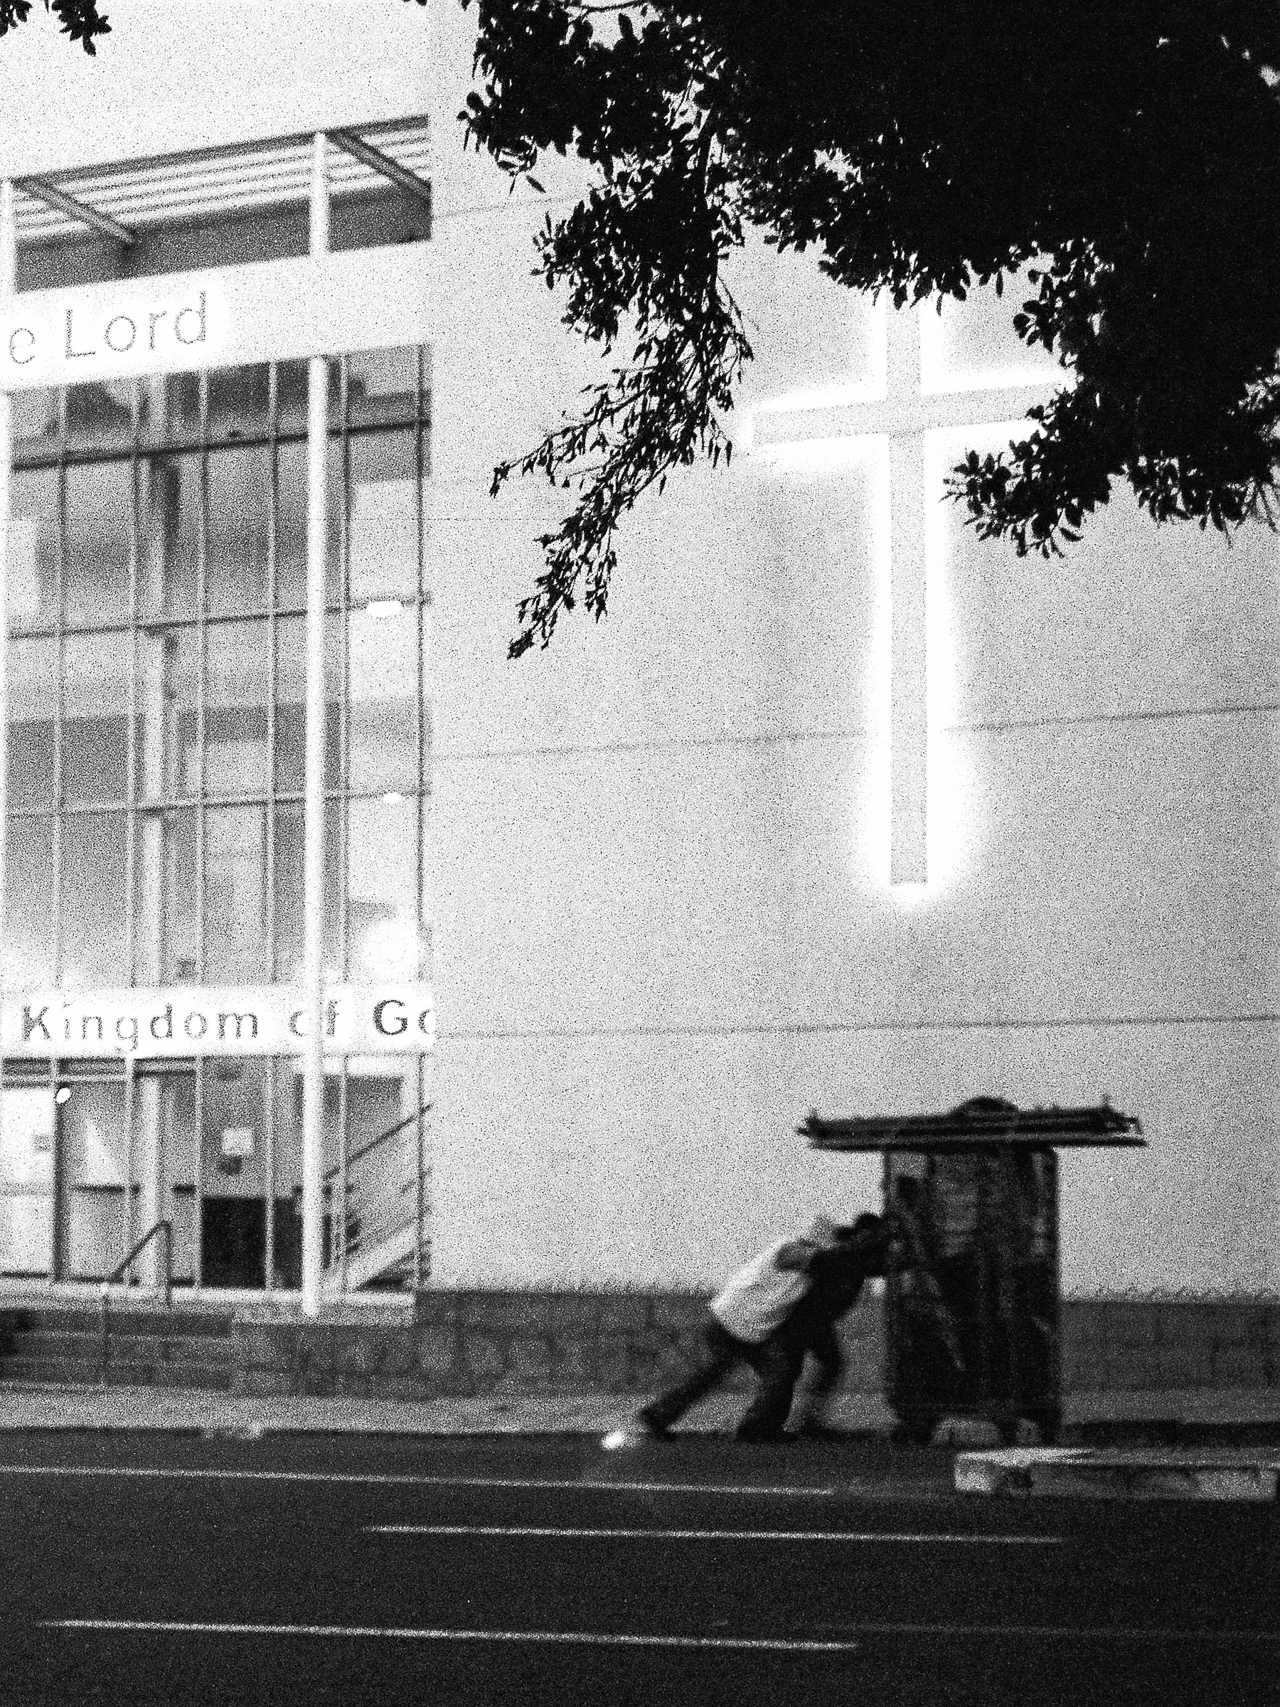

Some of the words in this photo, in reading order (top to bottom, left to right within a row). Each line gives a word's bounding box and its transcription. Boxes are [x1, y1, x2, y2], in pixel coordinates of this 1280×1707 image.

[65, 289, 208, 360] Lord
[22, 999, 258, 1052] Kingdom
[288, 1000, 341, 1038] of
[372, 999, 436, 1036] Go
